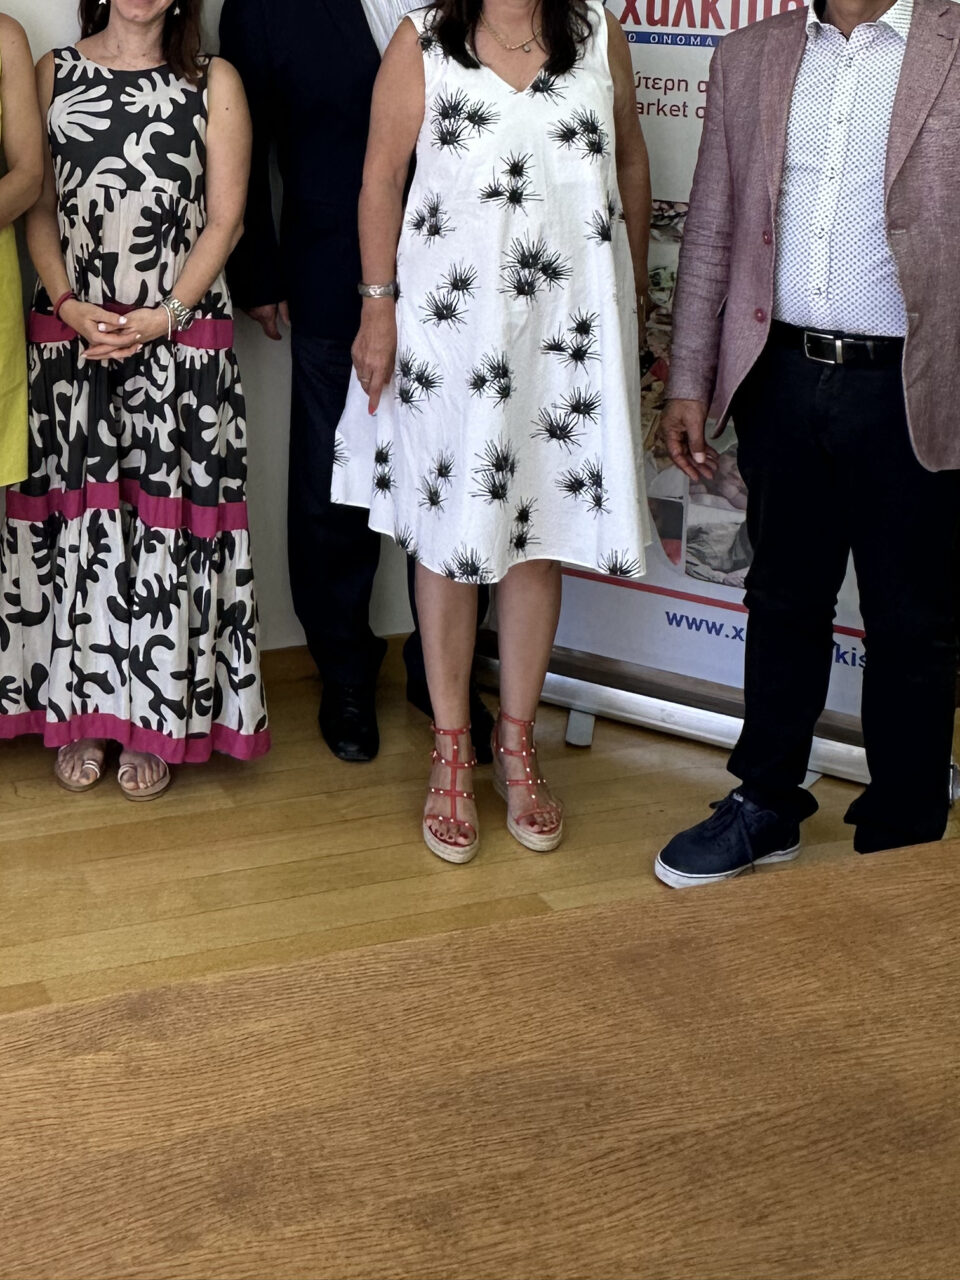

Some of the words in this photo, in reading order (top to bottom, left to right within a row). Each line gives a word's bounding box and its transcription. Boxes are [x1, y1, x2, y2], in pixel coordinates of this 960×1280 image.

[628, 32, 637, 43] Ο
[650, 32, 714, 47] ΟΝΟΜΑ
[634, 70, 689, 96] ύτερη
[636, 98, 689, 118] arket
